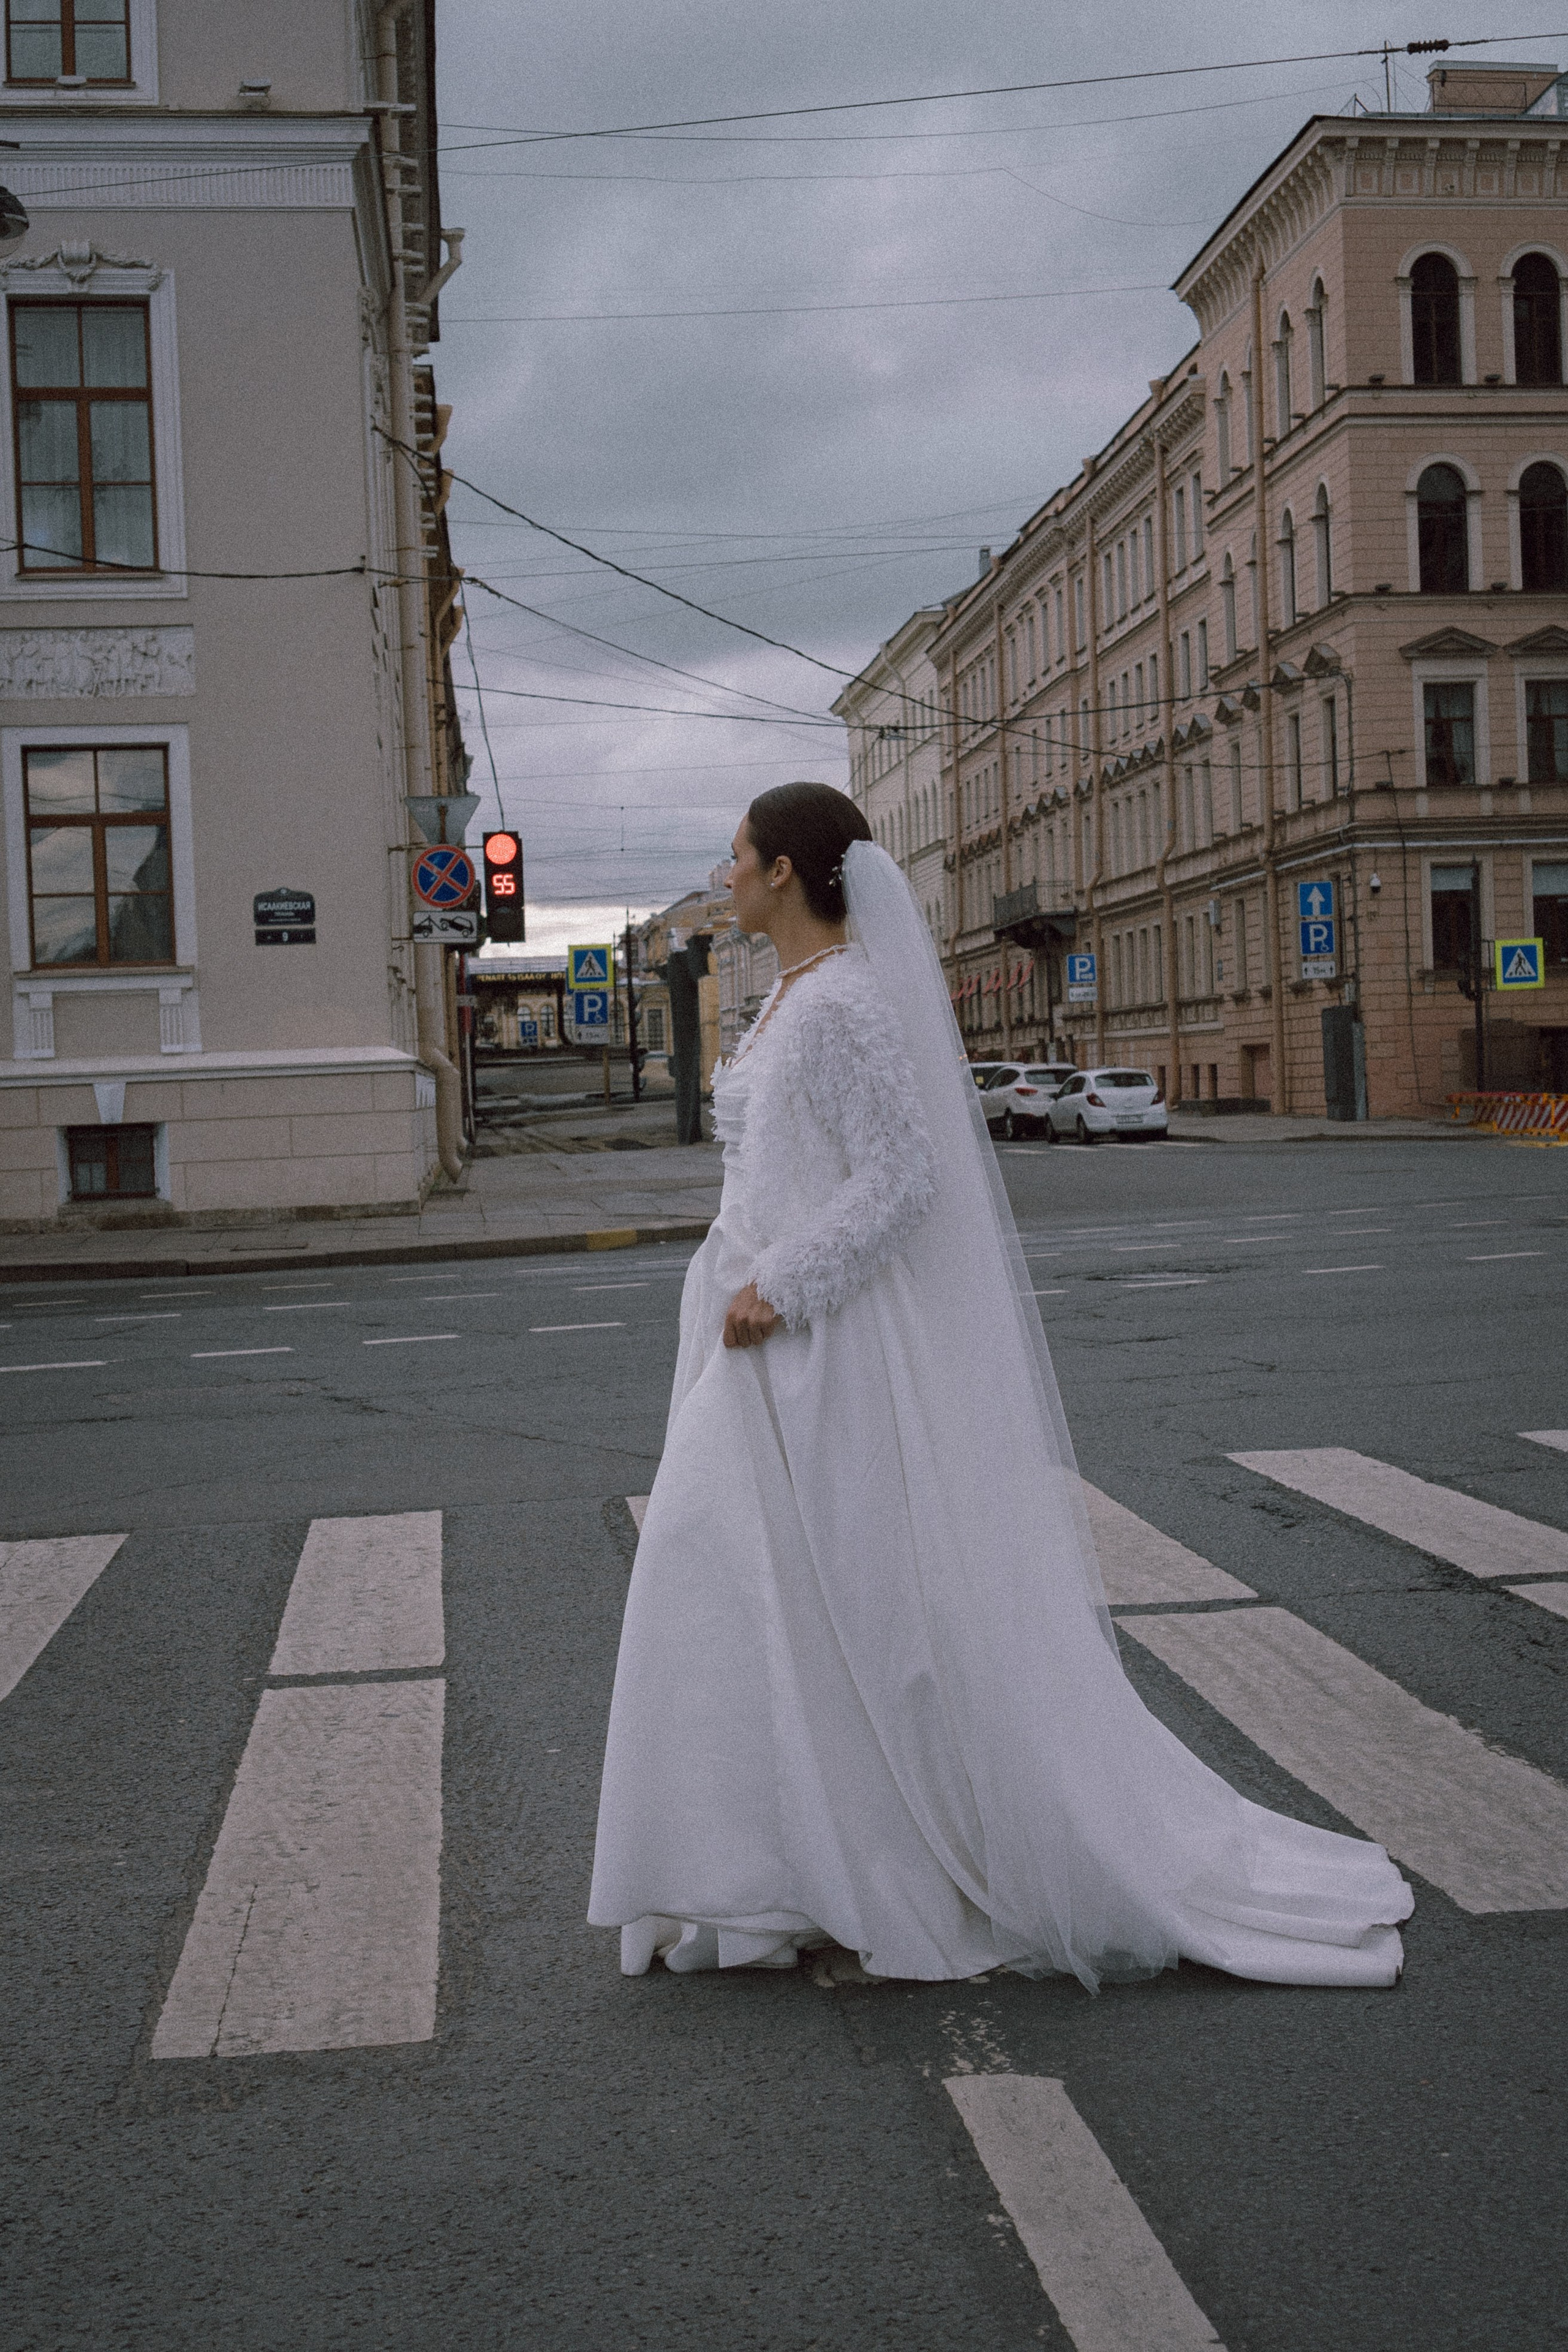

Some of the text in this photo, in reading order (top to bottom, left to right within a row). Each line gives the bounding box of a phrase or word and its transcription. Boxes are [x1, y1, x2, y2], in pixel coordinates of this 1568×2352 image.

[492, 873, 516, 895] 55
[258, 901, 311, 911] ИСААКИЕВСКАЯ
[282, 932, 288, 942] 9
[1075, 957, 1091, 981] P
[583, 994, 602, 1022] P
